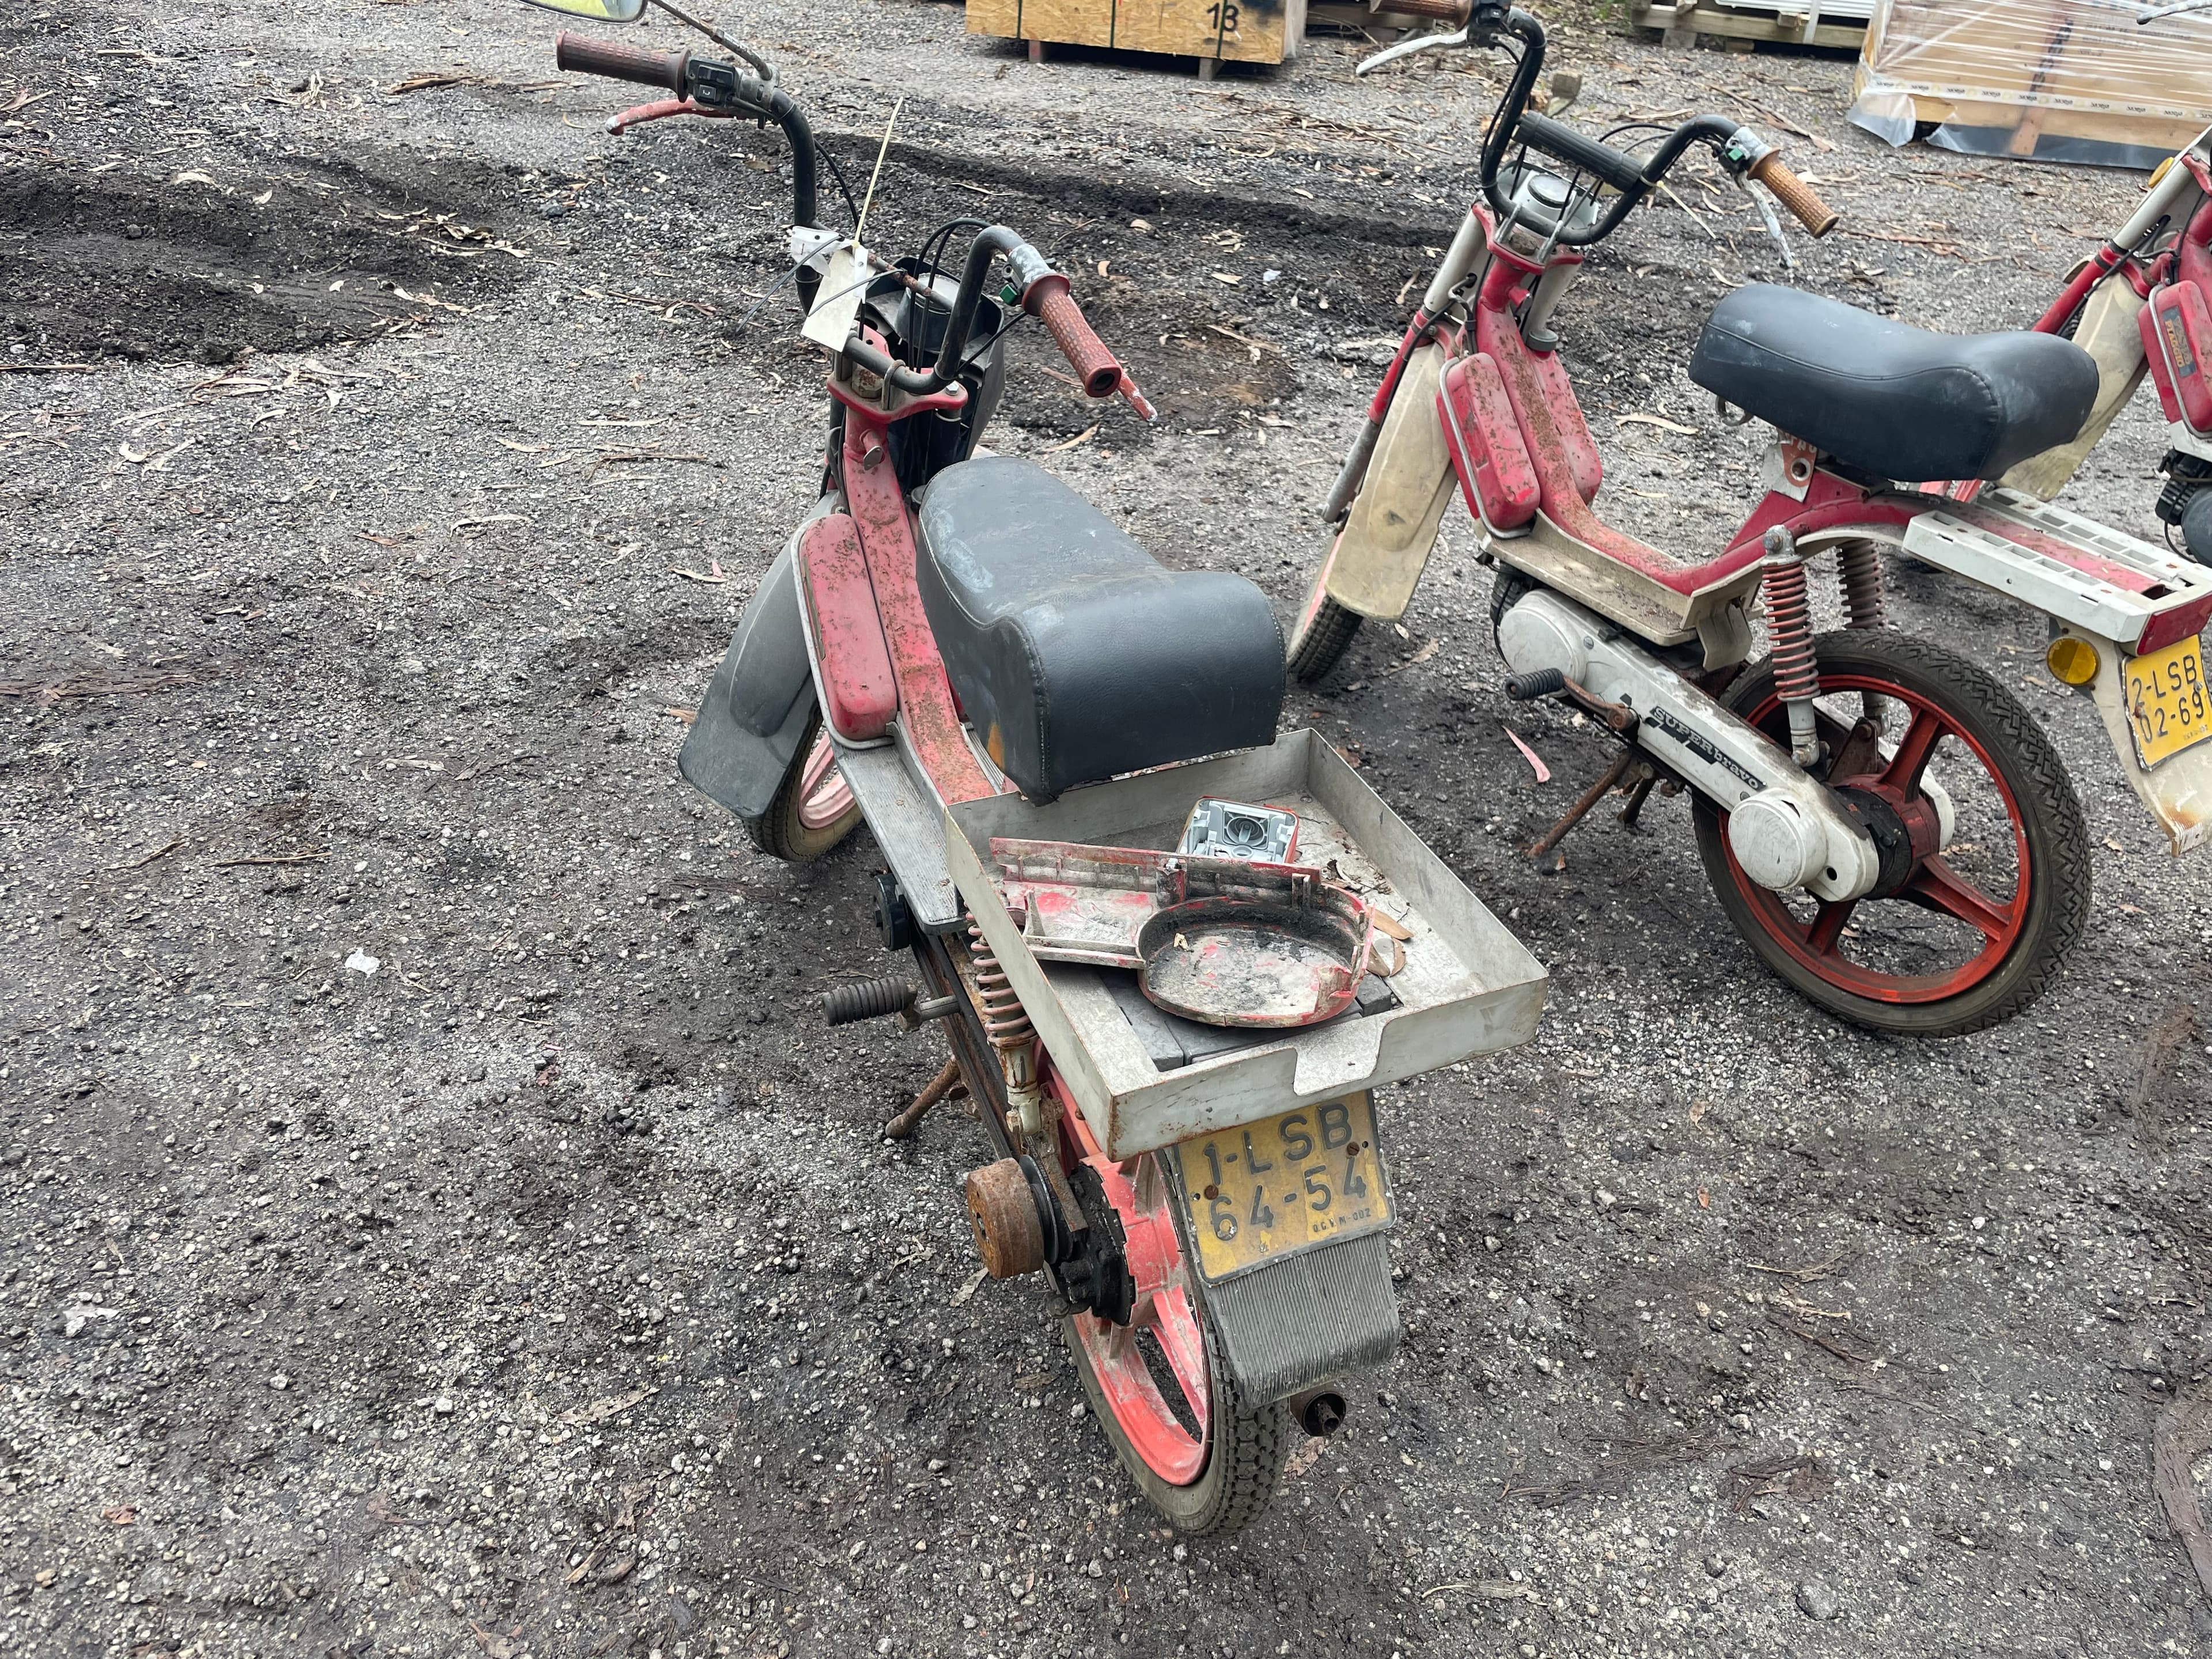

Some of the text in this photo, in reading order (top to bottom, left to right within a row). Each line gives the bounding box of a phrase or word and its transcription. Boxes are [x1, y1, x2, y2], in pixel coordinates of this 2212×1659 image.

[2165, 319, 2186, 368] PIAGGIO
[2132, 654, 2197, 708] 2-LSB
[2139, 690, 2204, 744] 02-69
[1204, 1103, 1353, 1185] 1-LSB
[1211, 1157, 1366, 1241] 64-54
